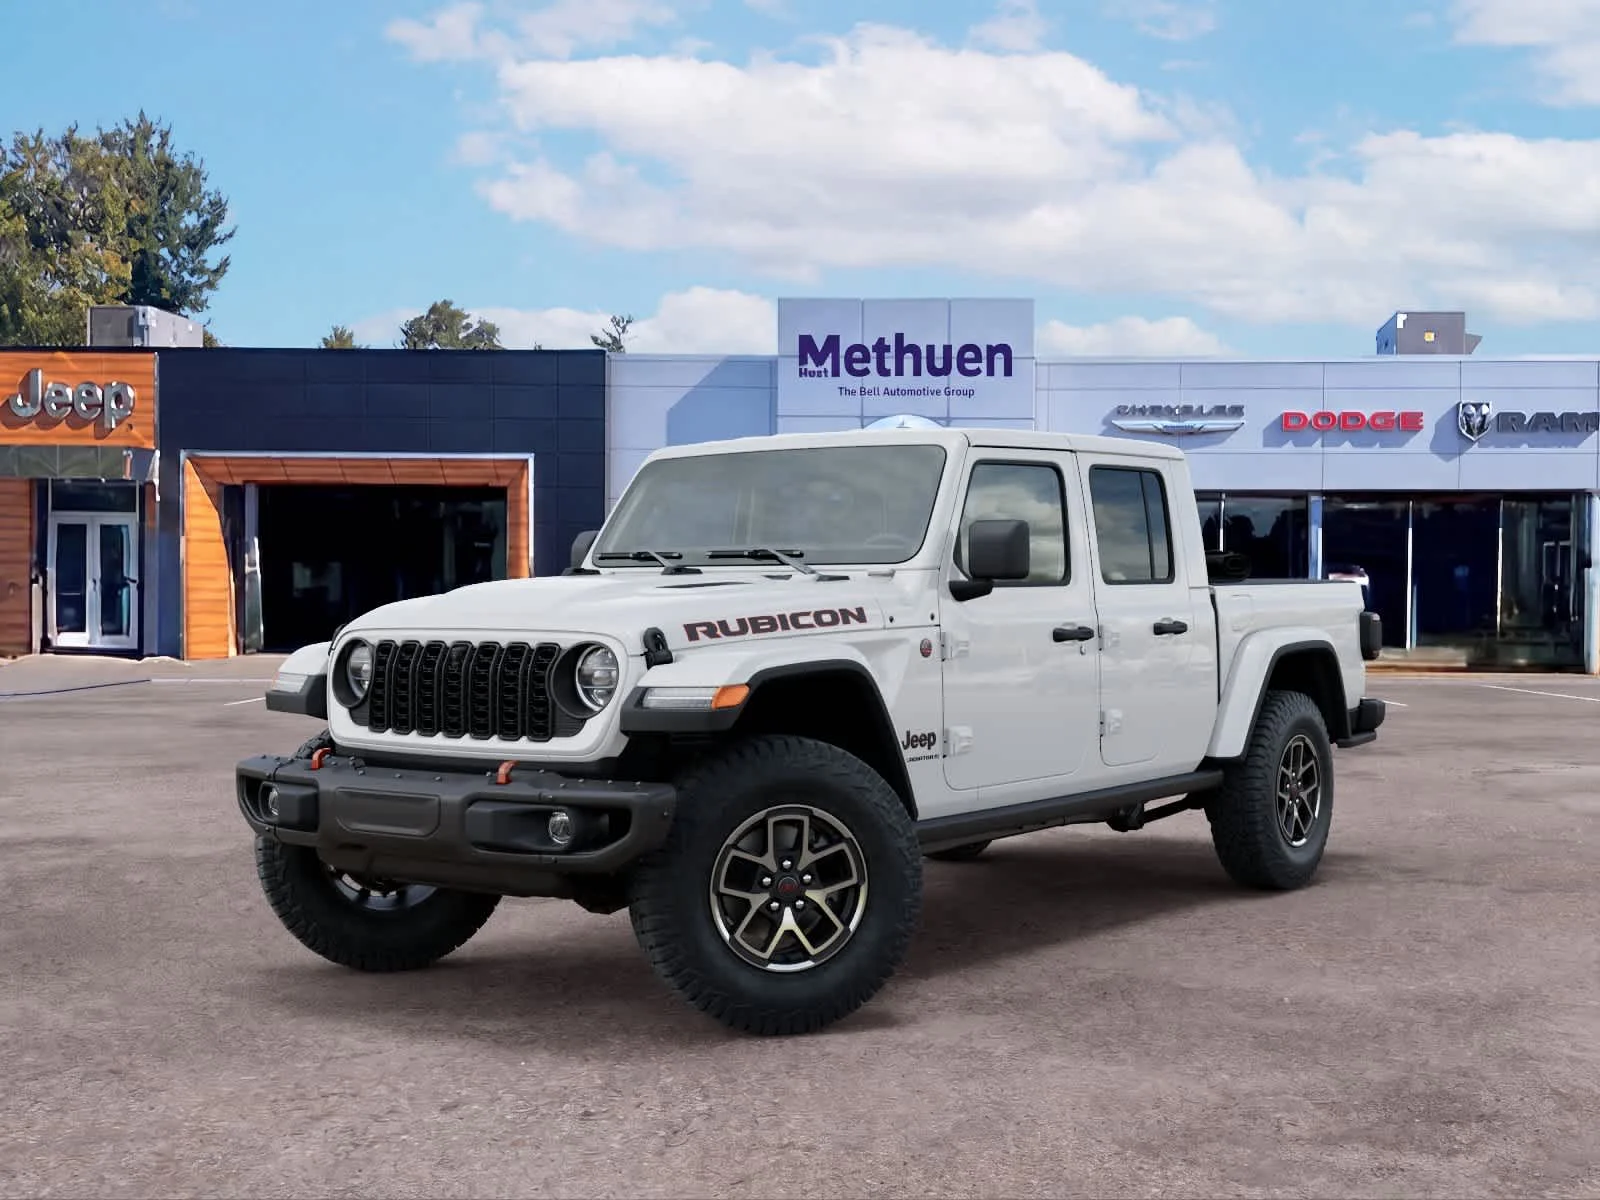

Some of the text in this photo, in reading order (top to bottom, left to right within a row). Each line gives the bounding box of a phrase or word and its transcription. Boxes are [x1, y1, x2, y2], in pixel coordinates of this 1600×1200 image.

[798, 333, 1013, 378] Methuen
[9, 368, 135, 429] Jeep
[838, 386, 975, 399] The Bell Automotive Group
[1281, 411, 1424, 432] DODGE
[1497, 411, 1600, 433] RAM
[683, 607, 867, 641] RUBICON
[901, 730, 937, 750] Jeep
